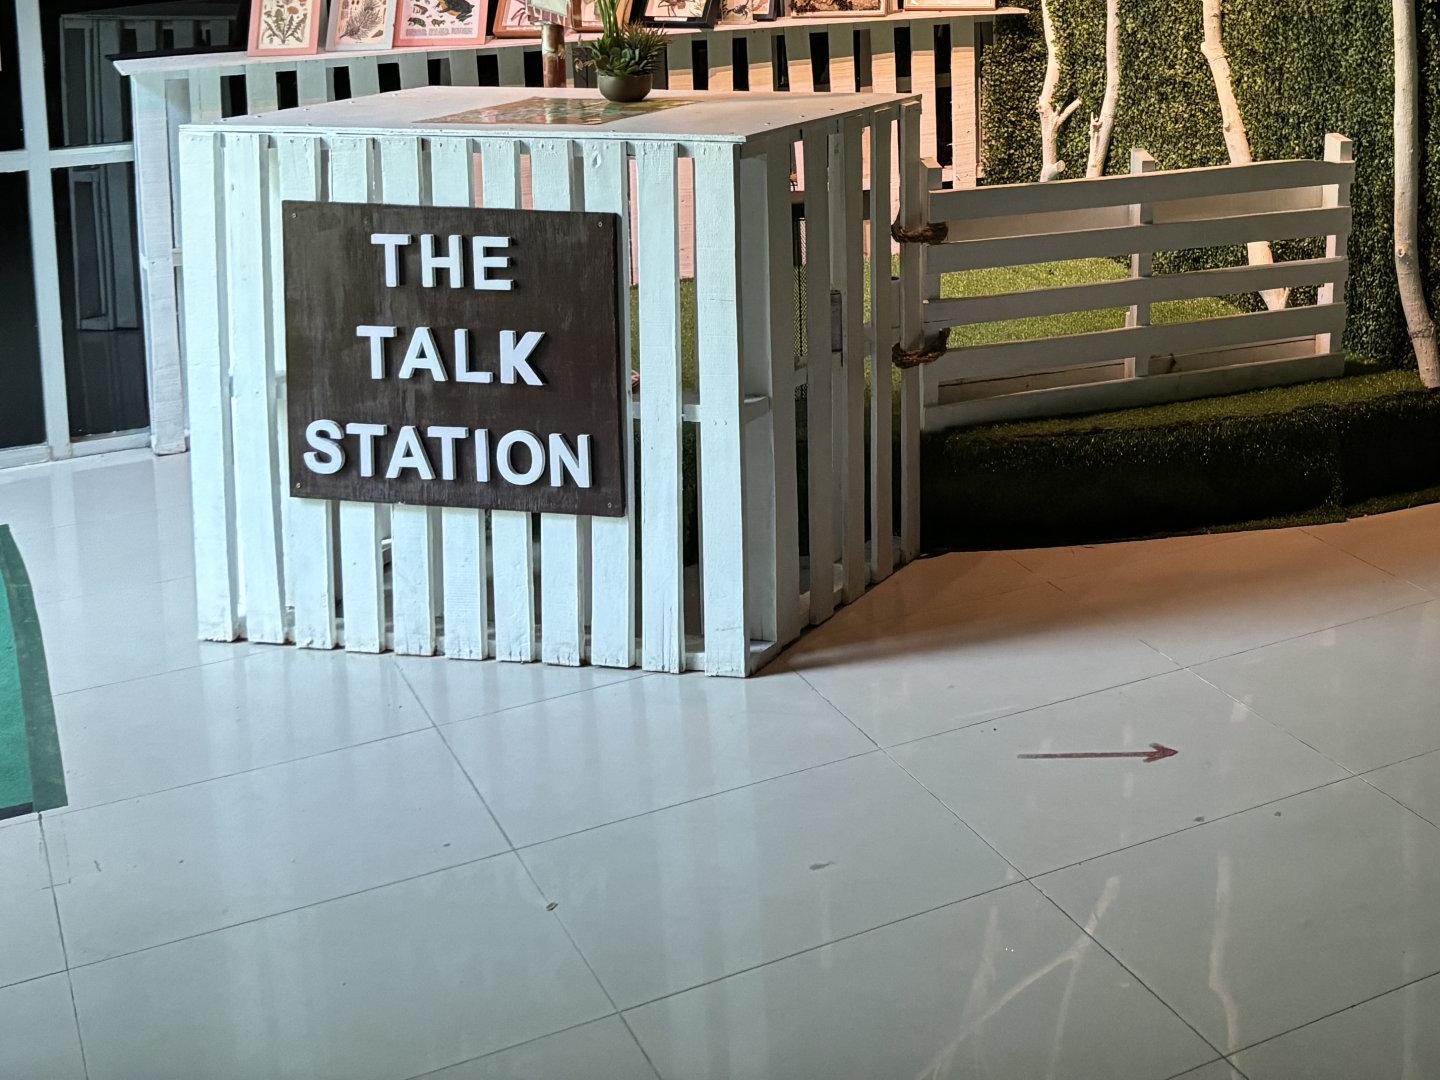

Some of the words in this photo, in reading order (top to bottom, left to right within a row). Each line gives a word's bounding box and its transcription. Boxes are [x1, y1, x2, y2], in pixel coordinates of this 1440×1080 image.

[370, 233, 515, 291] THE
[356, 325, 547, 387] TALK
[303, 420, 593, 489] STATION
